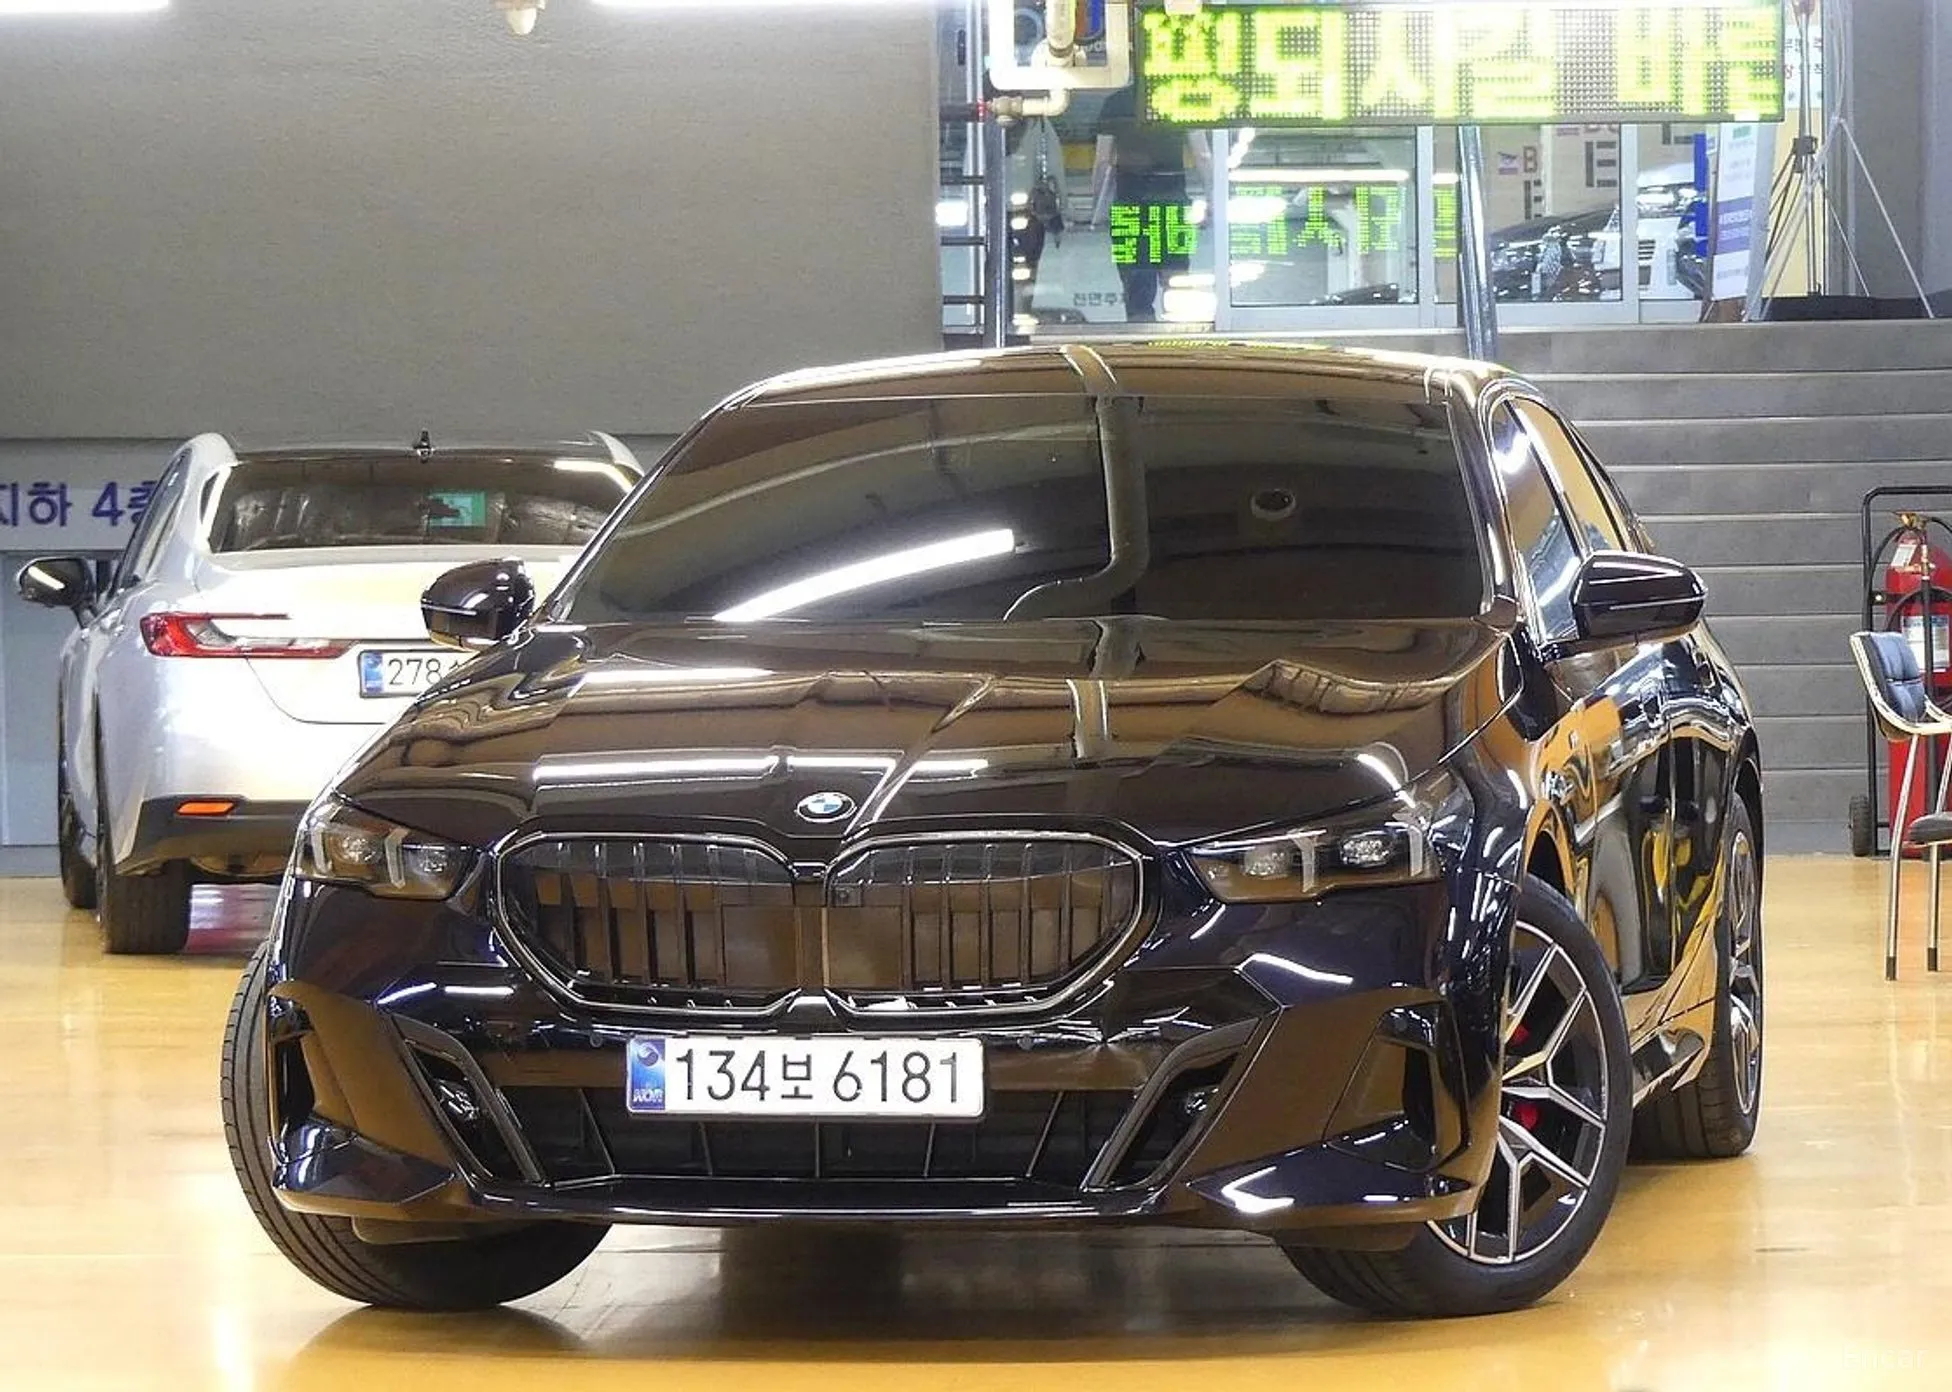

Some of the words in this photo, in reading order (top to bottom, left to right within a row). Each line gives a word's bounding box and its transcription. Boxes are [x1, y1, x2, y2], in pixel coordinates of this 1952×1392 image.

[388, 658, 459, 685] 278
[675, 1048, 813, 1100] 134보
[832, 1050, 958, 1103] 6181
